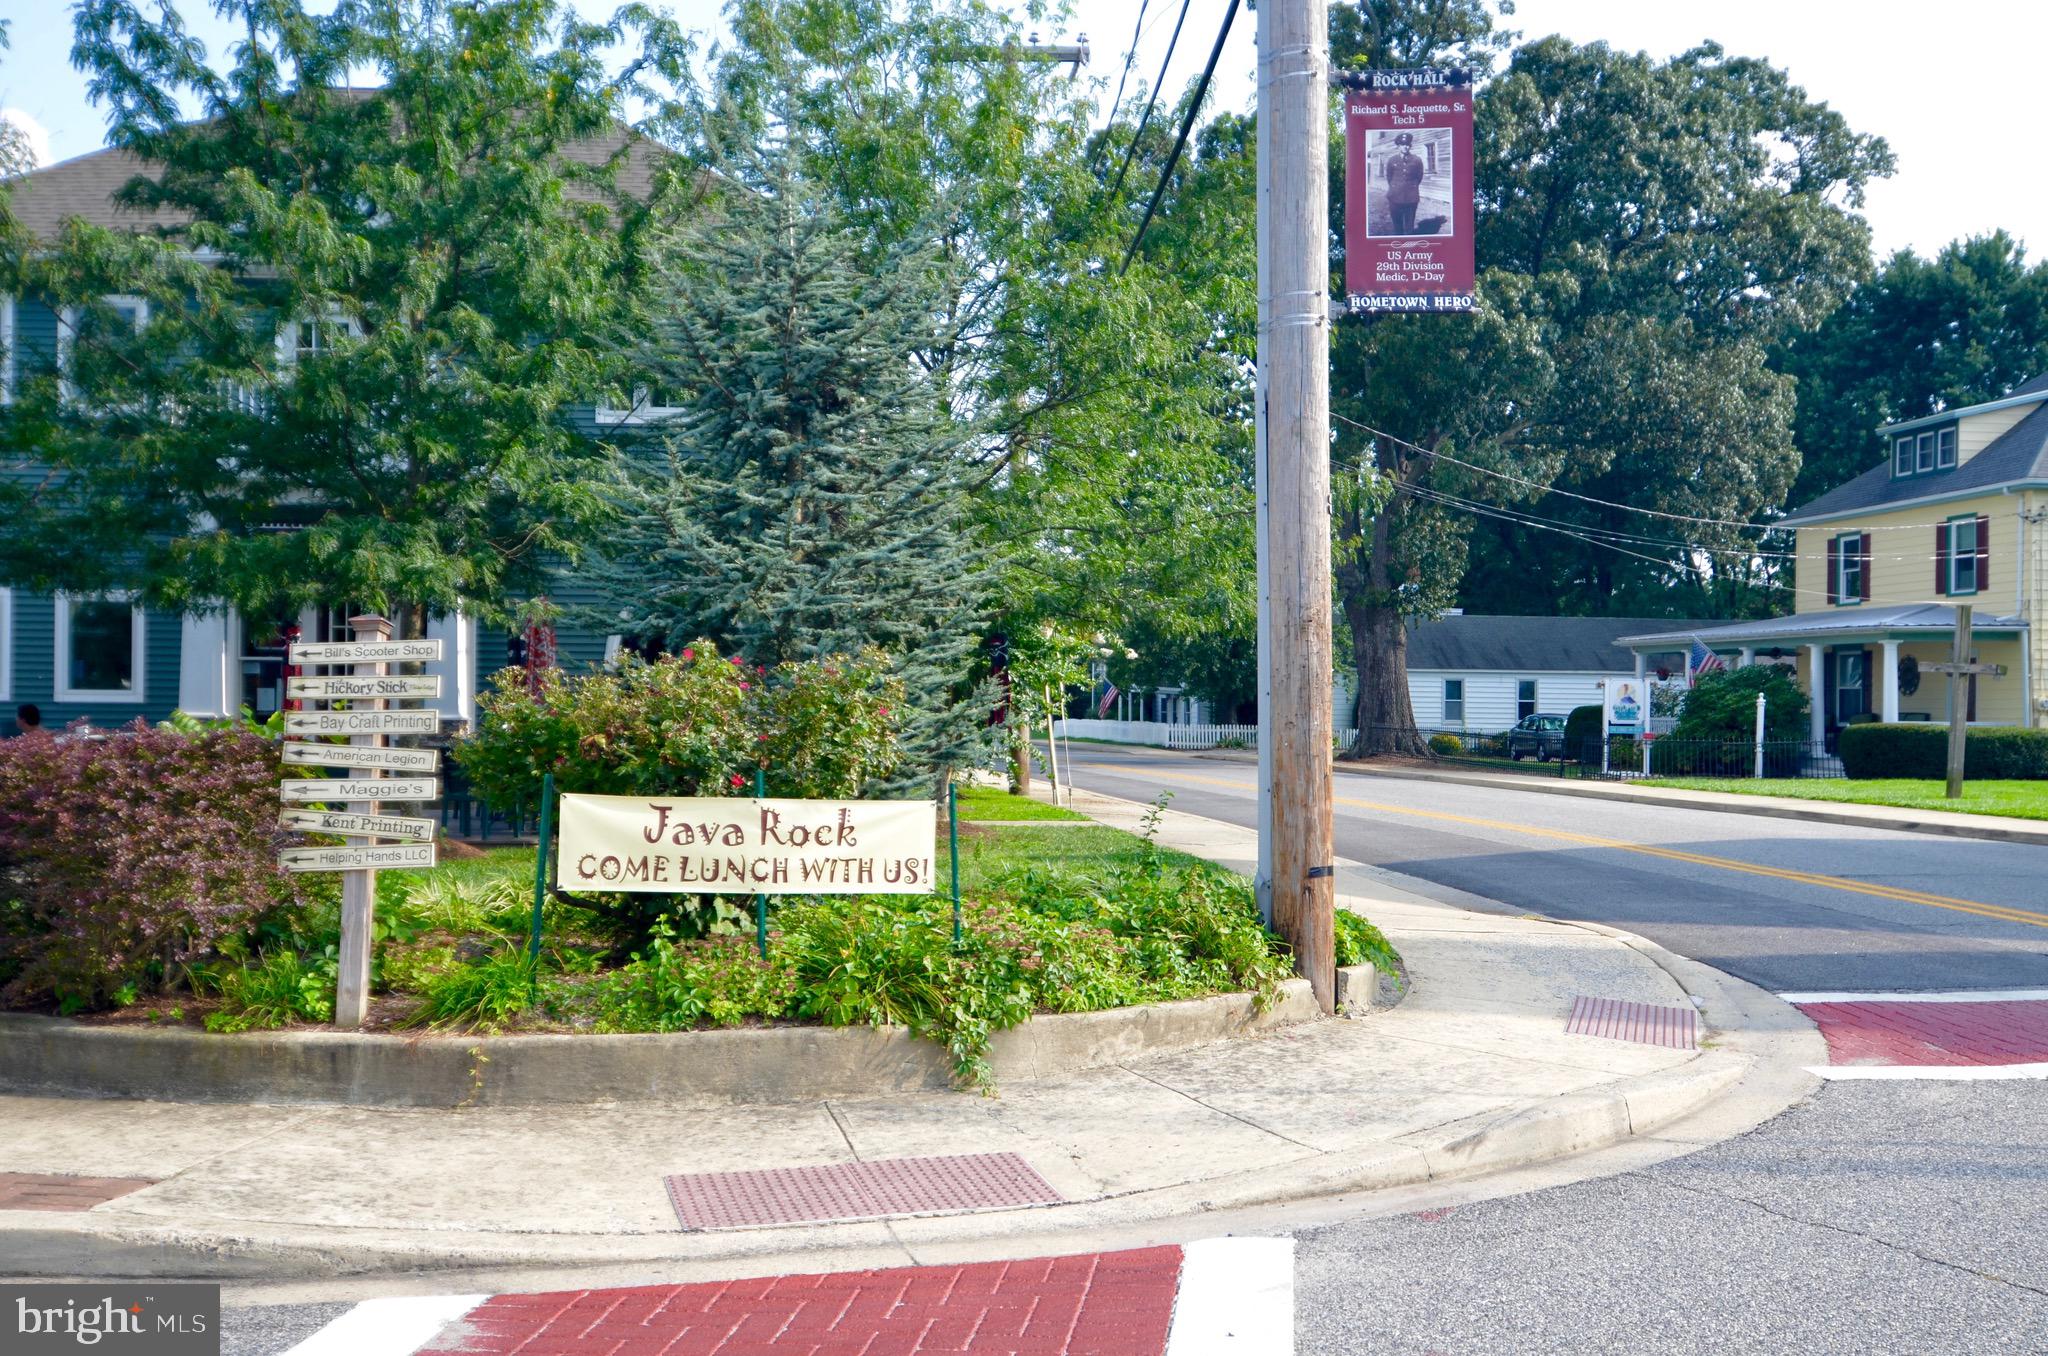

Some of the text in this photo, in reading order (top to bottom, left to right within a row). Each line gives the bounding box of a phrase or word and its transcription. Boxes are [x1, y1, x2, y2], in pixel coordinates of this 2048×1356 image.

[1372, 73, 1446, 87] ROCK HALL
[1351, 102, 1466, 114] Richard S. Jacquette, Sr.
[1392, 114, 1424, 124] Tech 5
[1387, 251, 1432, 262] US Army
[1376, 260, 1444, 270] 29th Division
[1376, 272, 1444, 282] Medic, D-Day
[1351, 296, 1472, 307] HOMETOWN HERO
[324, 646, 433, 658] Bill's Scooter Shop
[324, 681, 374, 694] Hickory
[376, 680, 408, 694] Stick
[320, 715, 432, 729] Bay Craft Printing
[323, 749, 426, 766] American Legion
[339, 784, 423, 796] Maggie's
[320, 815, 424, 836] Kent Printing
[643, 802, 857, 848] Java Rock
[320, 850, 428, 864] Helping Hands LLC
[575, 854, 928, 885] COME LUNCH WITH US!
